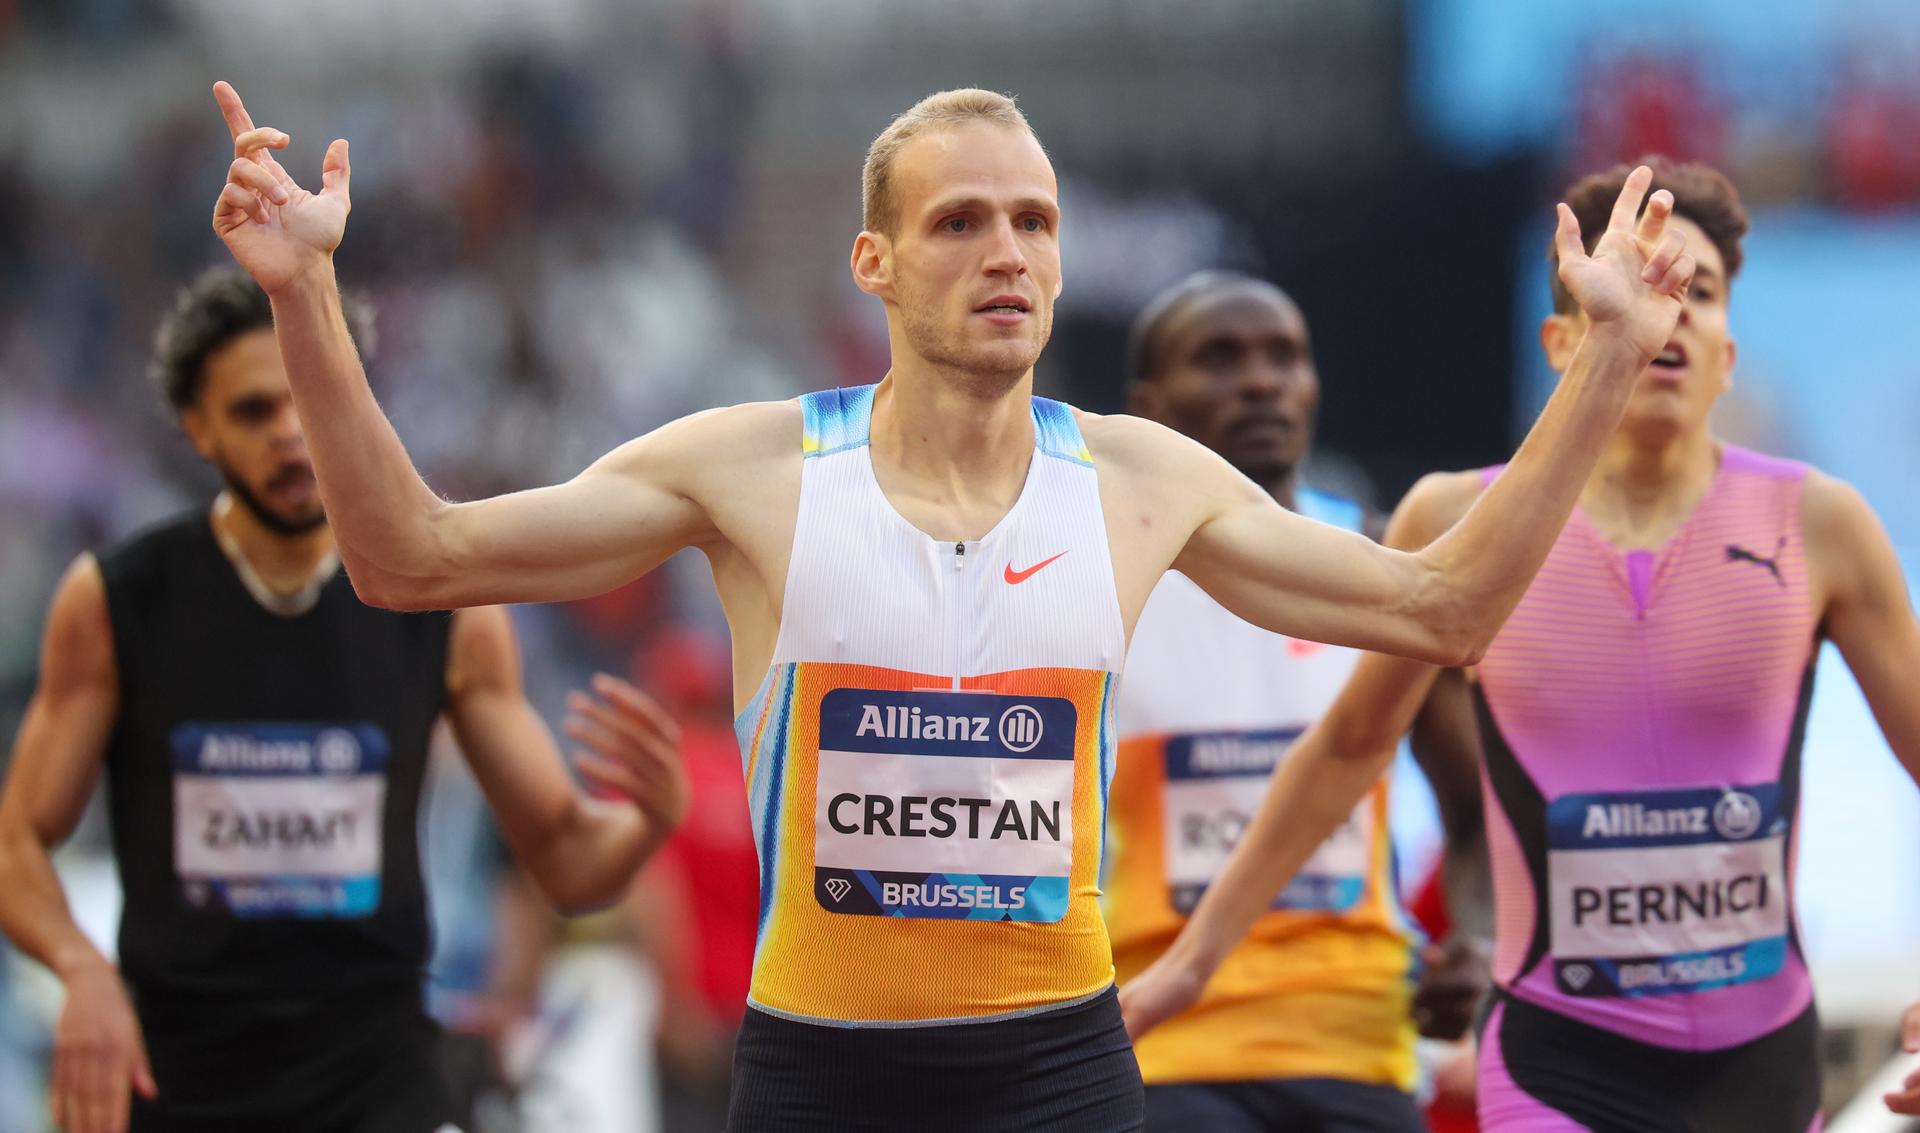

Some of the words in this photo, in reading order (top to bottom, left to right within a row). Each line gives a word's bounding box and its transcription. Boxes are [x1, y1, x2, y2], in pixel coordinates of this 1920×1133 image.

[855, 704, 990, 742] Allianz
[827, 792, 1061, 842] CRESTAN
[1581, 802, 1709, 838] Allianz
[882, 882, 1026, 910] BRUSSELS
[1571, 873, 1769, 929] PERNICI
